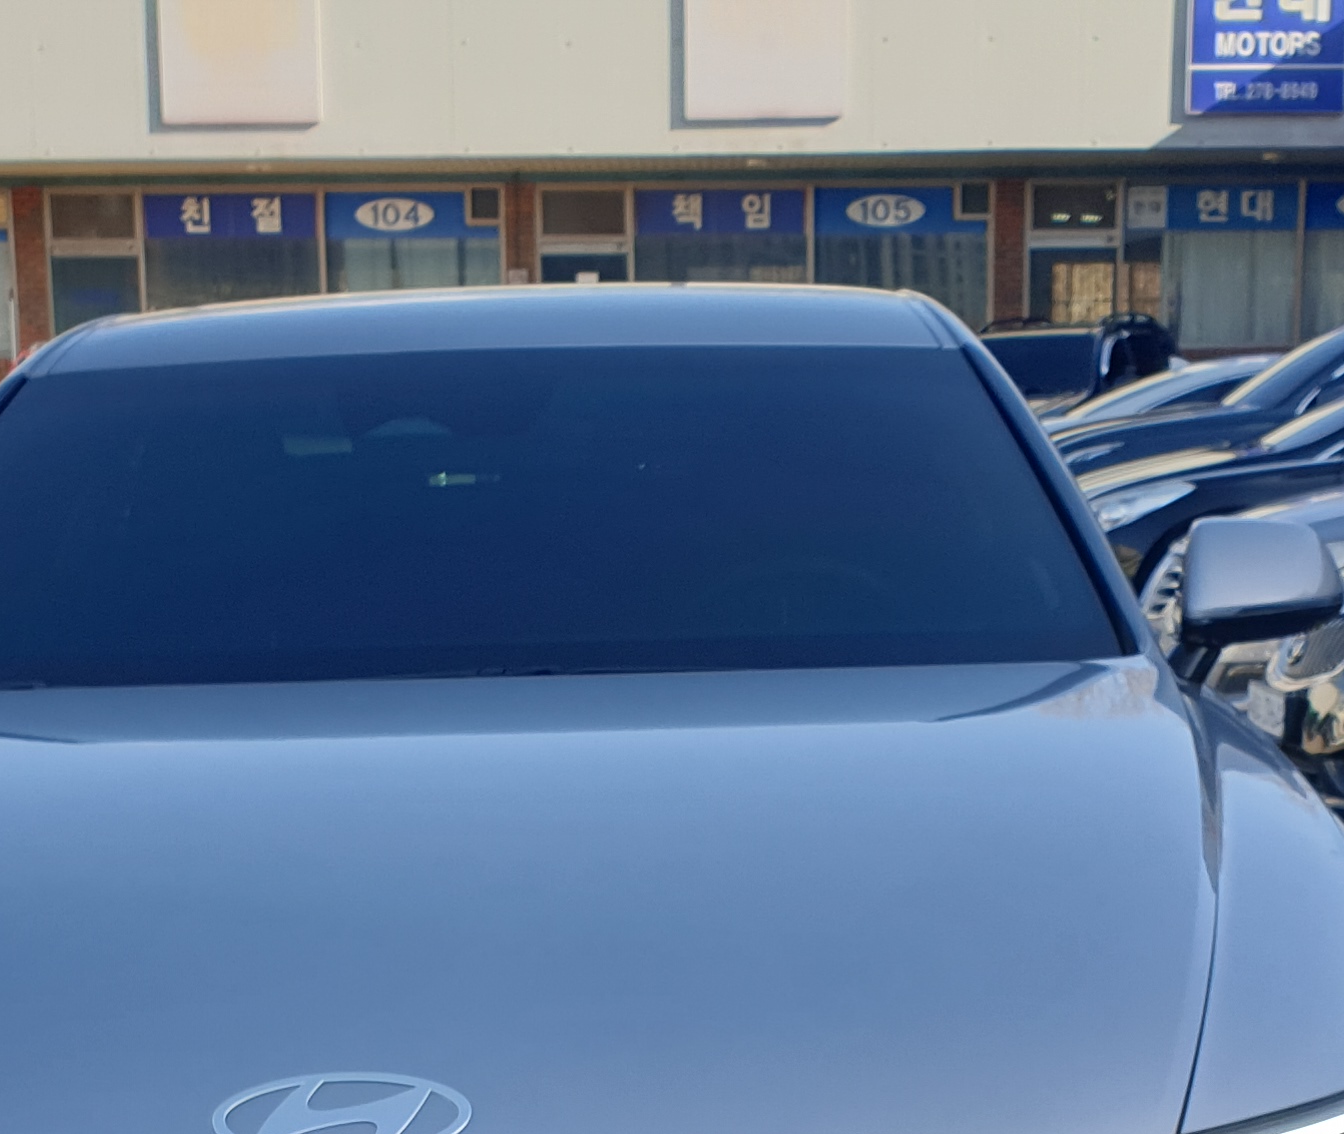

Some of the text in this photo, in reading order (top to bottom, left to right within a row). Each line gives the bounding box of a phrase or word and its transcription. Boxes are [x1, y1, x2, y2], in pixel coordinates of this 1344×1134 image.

[1215, 30, 1322, 57] MOTORS
[371, 203, 420, 226] 104
[860, 199, 911, 223] 105
